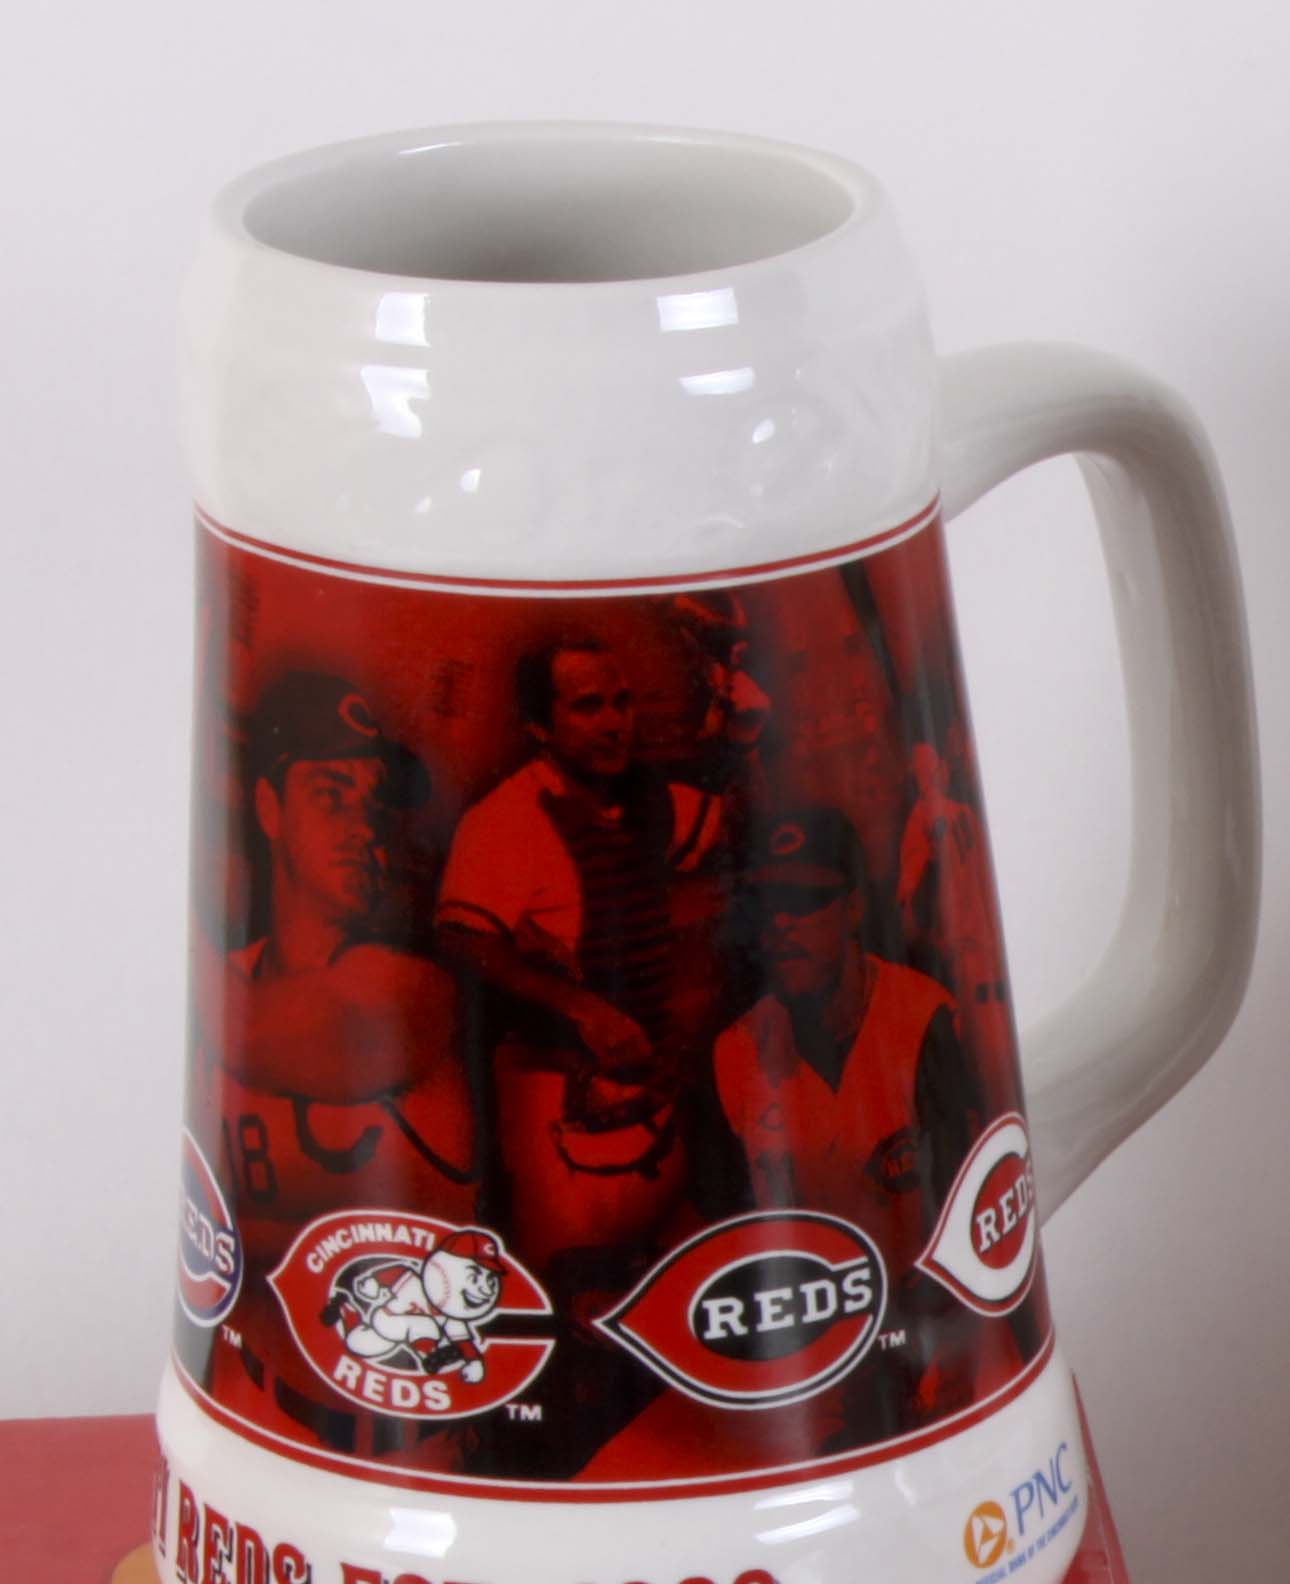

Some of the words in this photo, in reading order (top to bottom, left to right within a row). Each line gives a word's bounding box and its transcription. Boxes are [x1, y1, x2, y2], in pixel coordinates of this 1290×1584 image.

[185, 1199, 237, 1275] EDS
[304, 1222, 436, 1275] CINCINNATI
[702, 1267, 874, 1341] REDS
[877, 1329, 907, 1352] TM
[333, 1353, 453, 1412] REDS
[504, 1401, 543, 1422] TM
[1009, 1440, 1074, 1538] PNC
